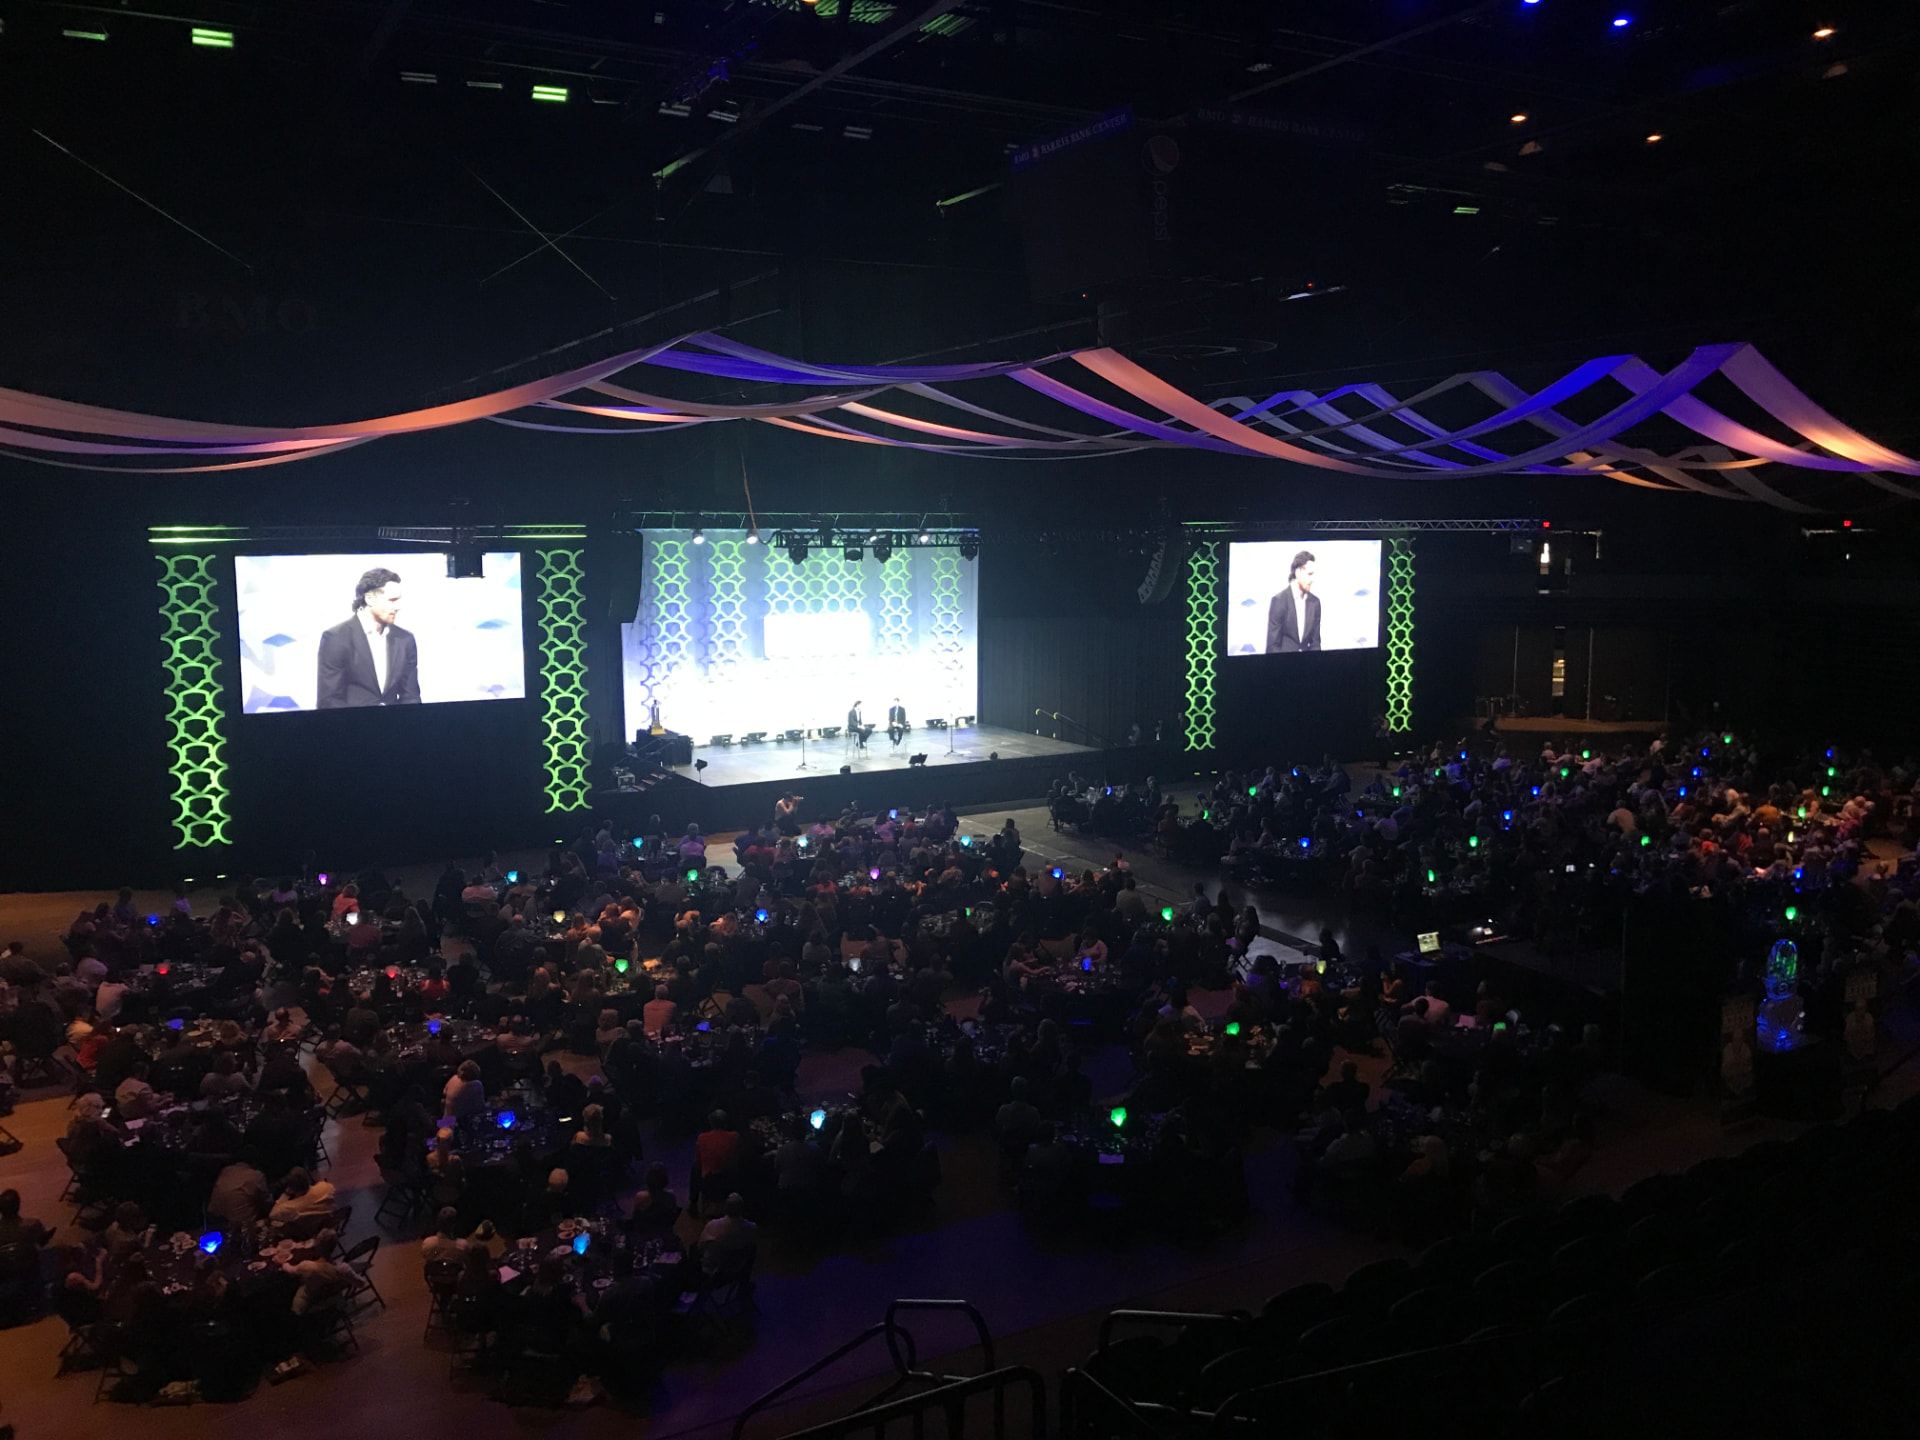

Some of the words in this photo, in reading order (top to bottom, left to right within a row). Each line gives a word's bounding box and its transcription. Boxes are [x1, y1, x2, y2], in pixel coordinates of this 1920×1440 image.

[1013, 152, 1030, 165] BMO
[1040, 135, 1070, 154] HARRIS
[1070, 127, 1092, 143] BANK
[1092, 113, 1127, 134] CENTER
[1198, 108, 1224, 121] BMO
[1248, 115, 1289, 132] HARRIS
[1291, 121, 1320, 136] BANK
[1152, 180, 1172, 241] pepsi
[175, 291, 318, 334] BMO
